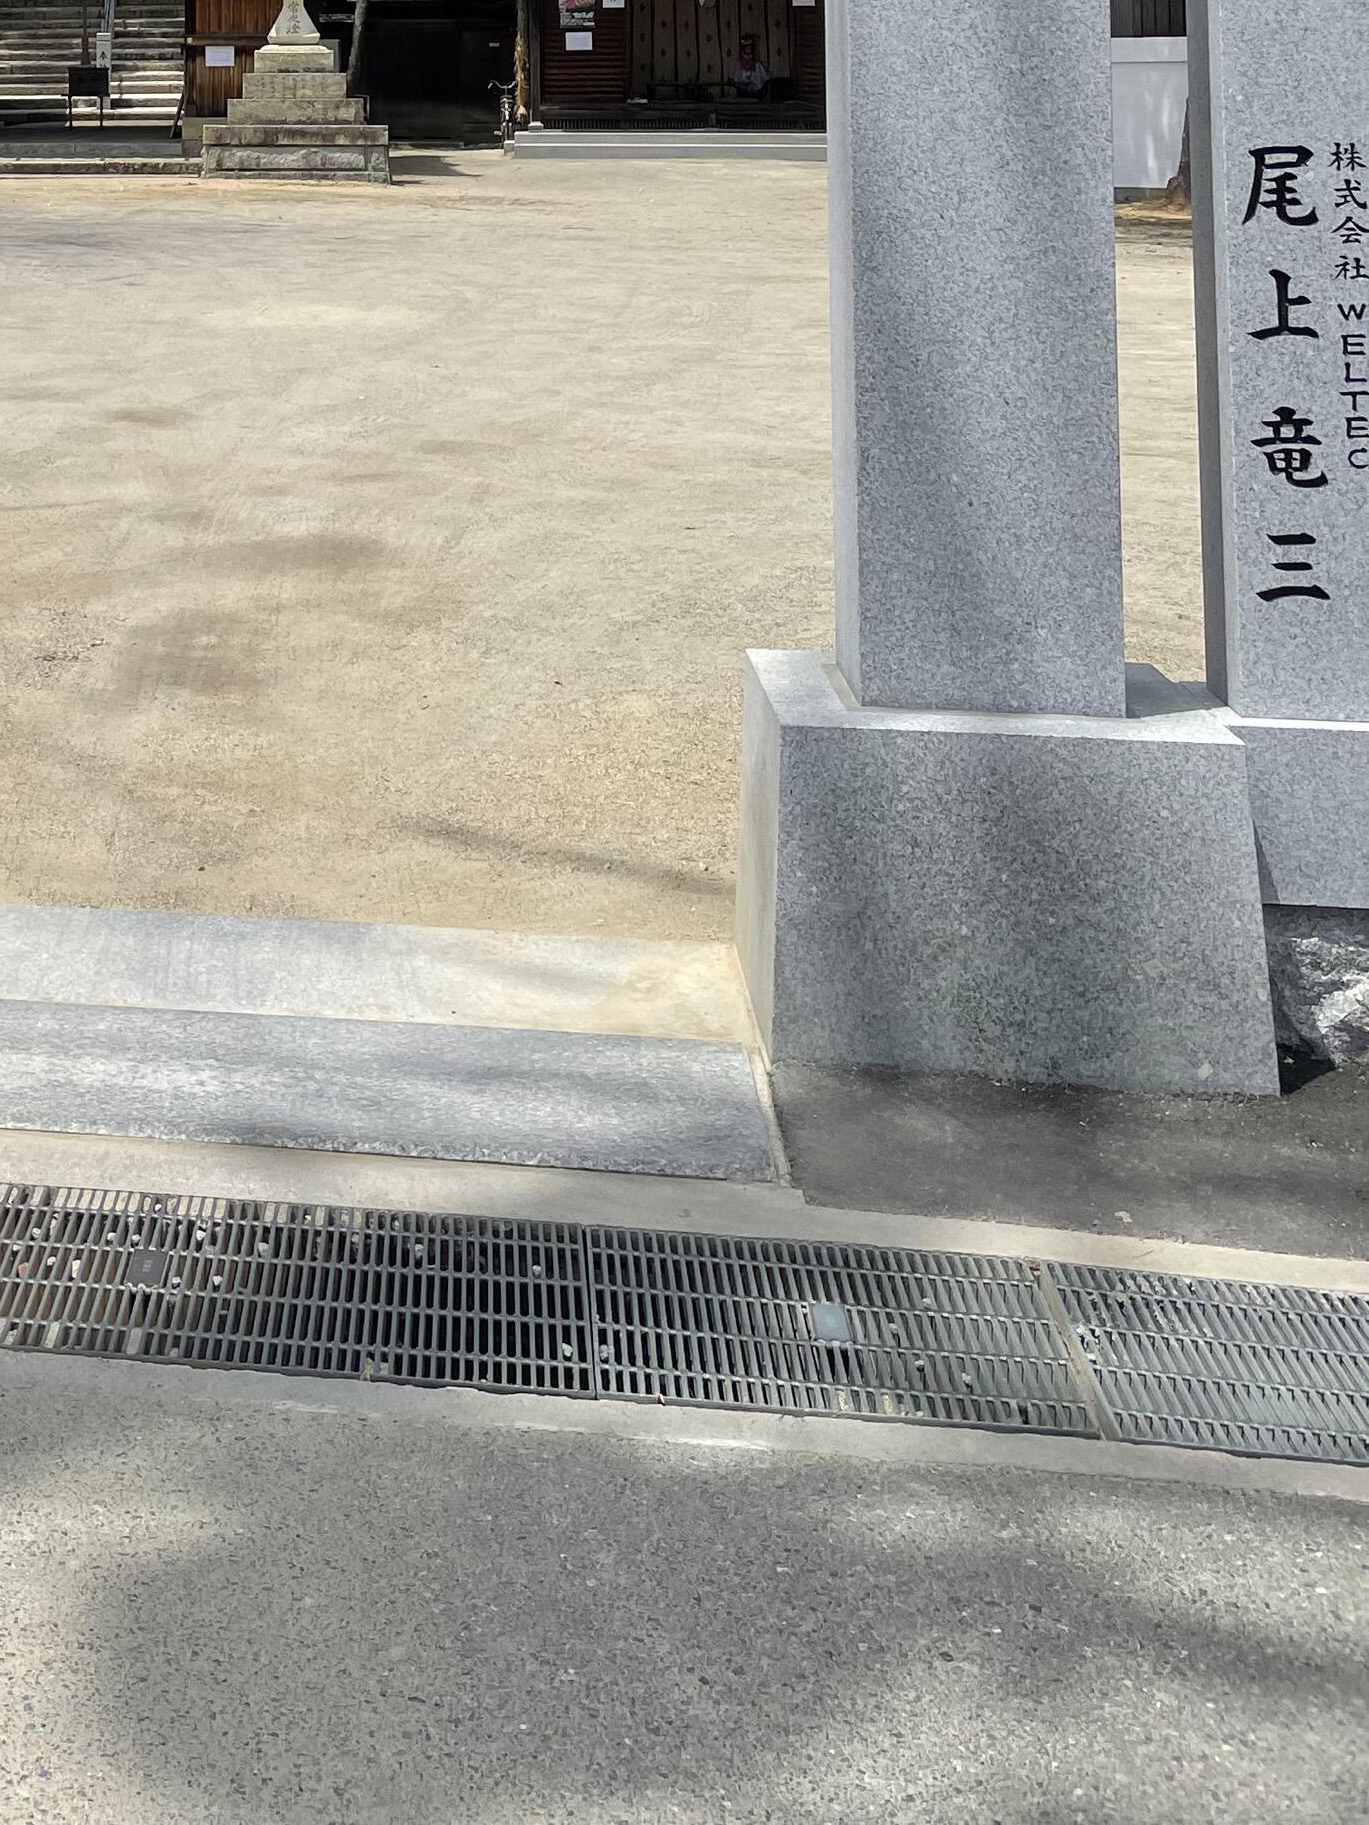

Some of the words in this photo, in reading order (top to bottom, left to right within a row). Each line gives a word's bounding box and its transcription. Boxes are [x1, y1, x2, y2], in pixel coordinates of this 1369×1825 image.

[1329, 142, 1369, 280] 株式会社
[1243, 145, 1330, 602] 尾上竜三
